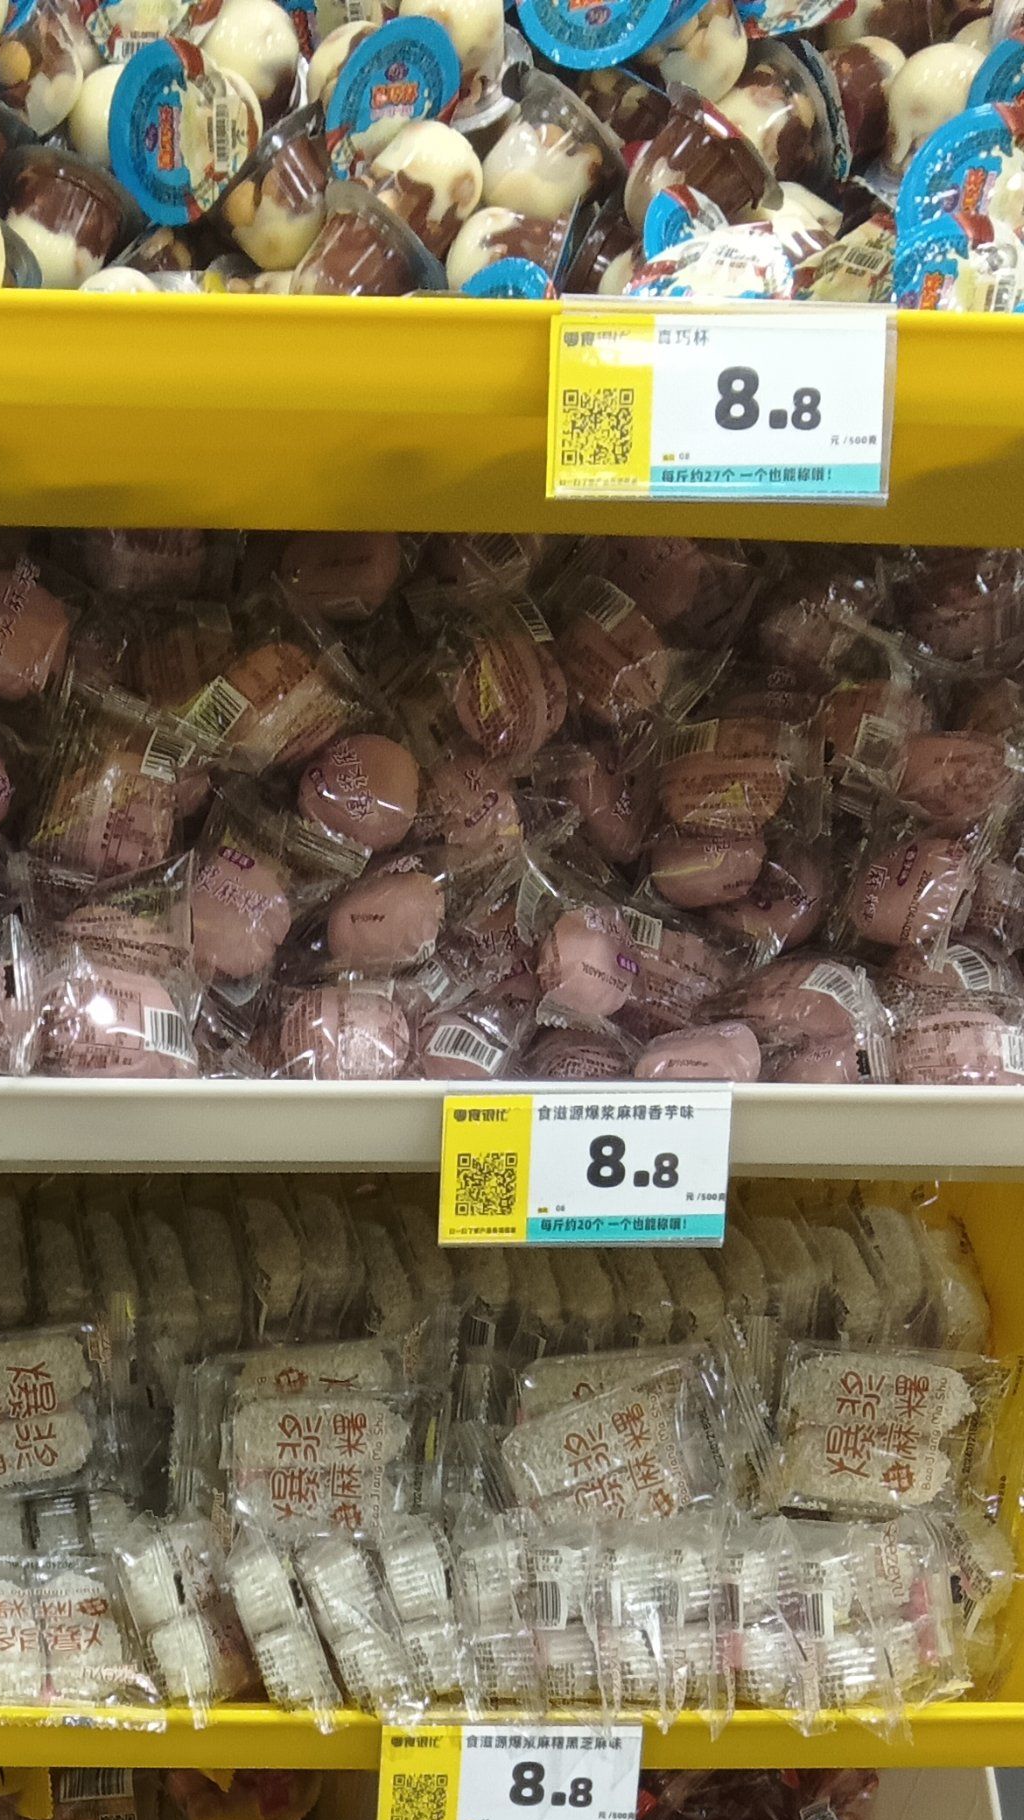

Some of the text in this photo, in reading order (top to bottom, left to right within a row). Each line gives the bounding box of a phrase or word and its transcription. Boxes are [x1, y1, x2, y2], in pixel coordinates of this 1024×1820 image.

[715, 365, 822, 431] 8.8
[586, 1134, 679, 1189] 8.8
[509, 1761, 593, 1808] 8.8
